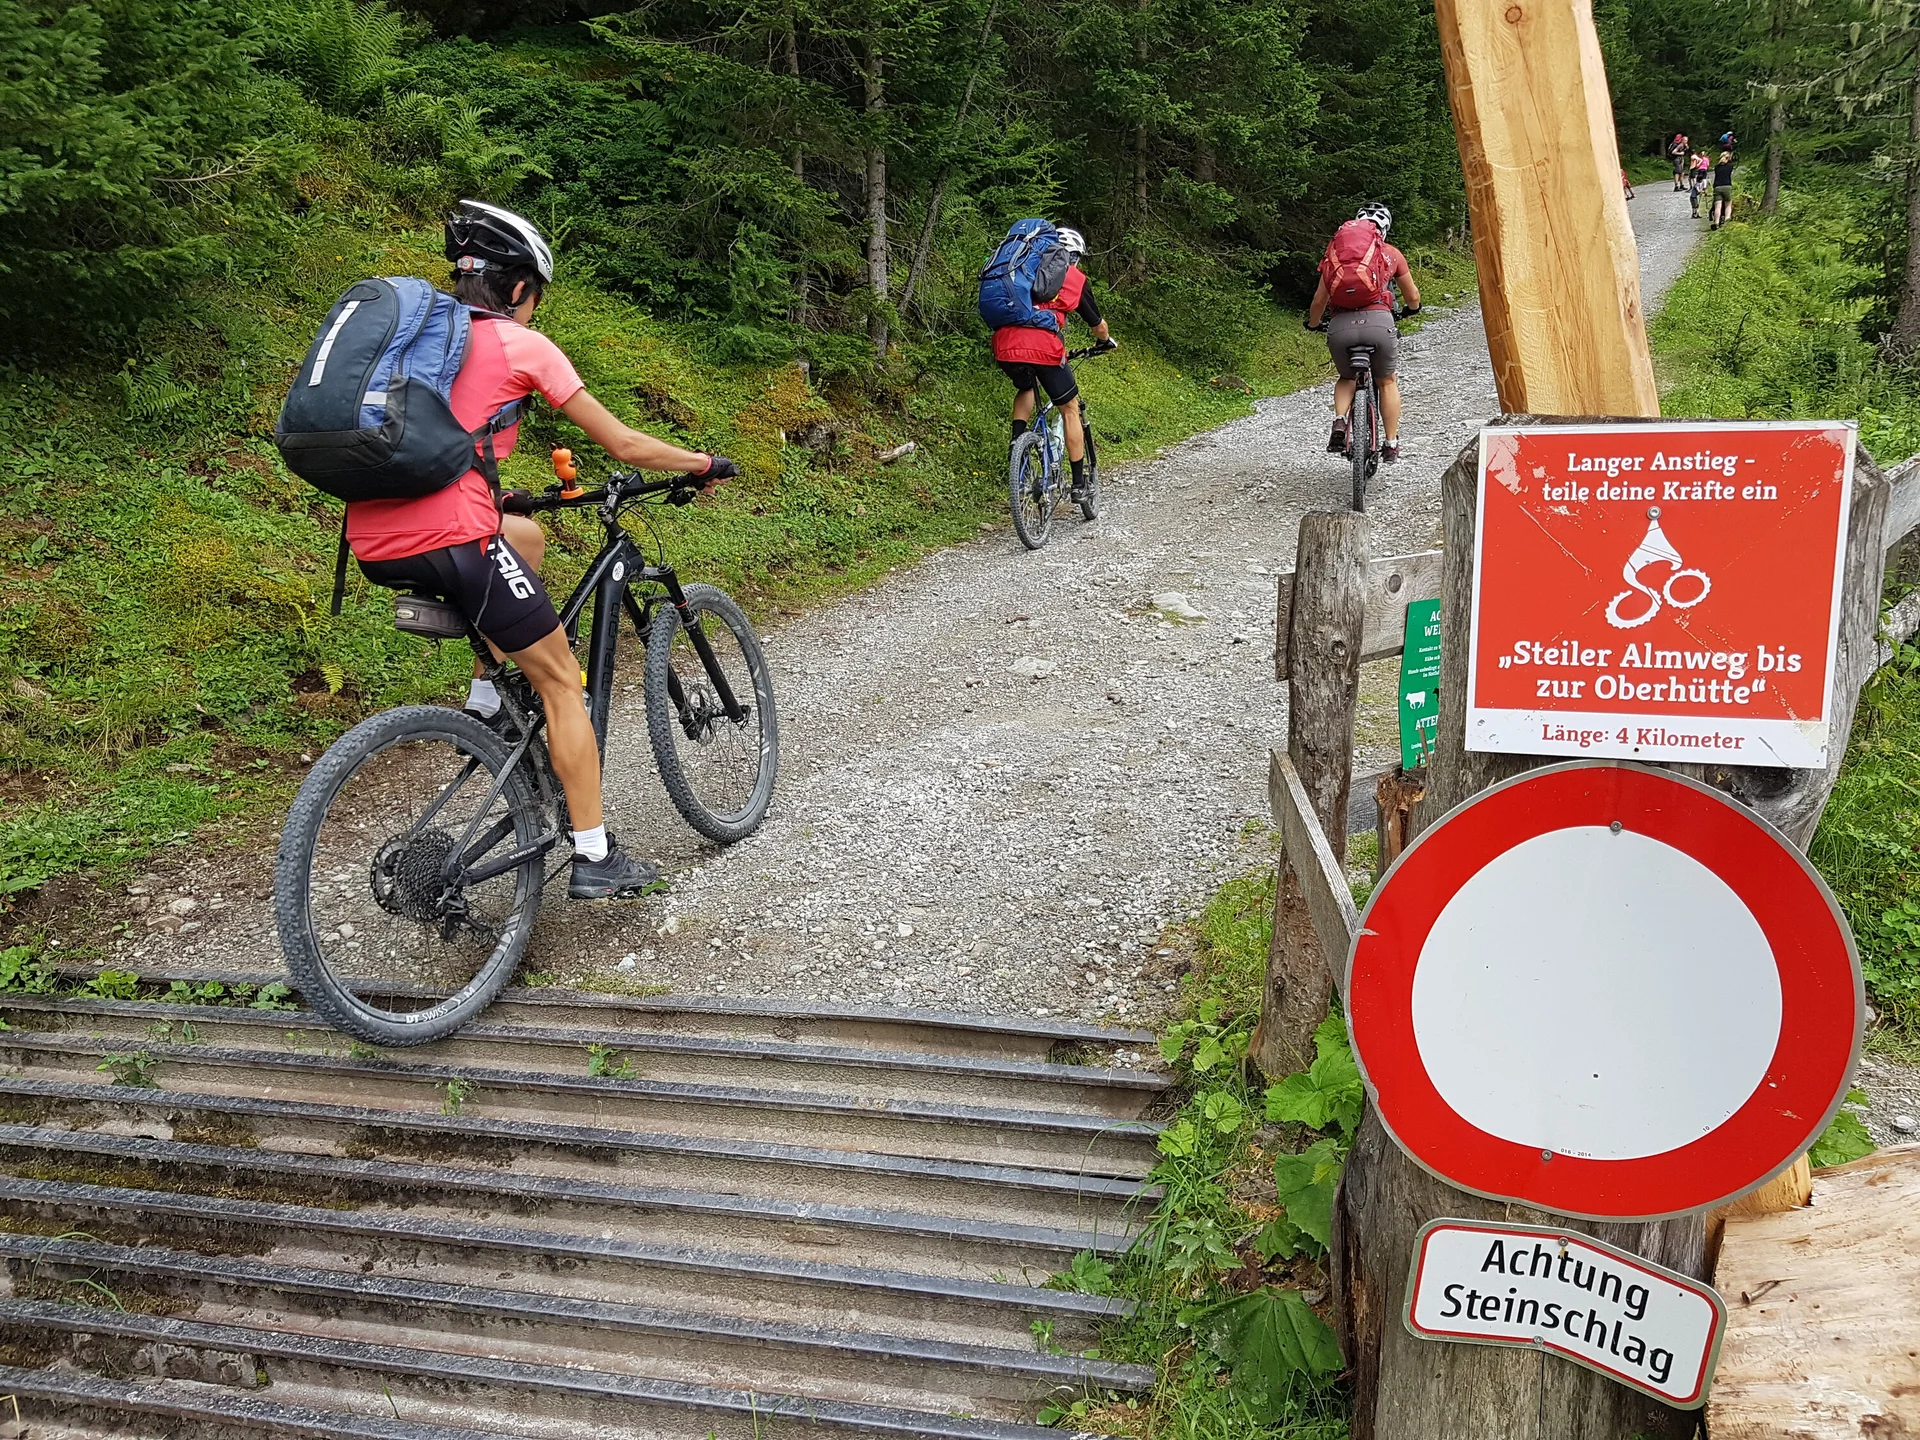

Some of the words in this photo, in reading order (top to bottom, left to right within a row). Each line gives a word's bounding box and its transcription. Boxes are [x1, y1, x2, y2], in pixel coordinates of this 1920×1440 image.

[1567, 452, 1645, 476] Langer
[1649, 451, 1739, 476] Anstieg
[1542, 481, 1590, 501] teile
[1596, 481, 1656, 501] deine
[1662, 480, 1736, 500] Kräfte
[1741, 480, 1778, 500] ein
[1619, 642, 1749, 679] Almweg
[1757, 645, 1802, 673] bis
[1536, 676, 1586, 700] zur
[1541, 724, 1610, 748] Länge:
[1615, 726, 1629, 744] 4
[1636, 728, 1745, 750] Kilometer
[421, 1005, 449, 1022] SWISS
[1481, 1239, 1650, 1321] Achtung
[1440, 1283, 1675, 1384] Steinschlag
